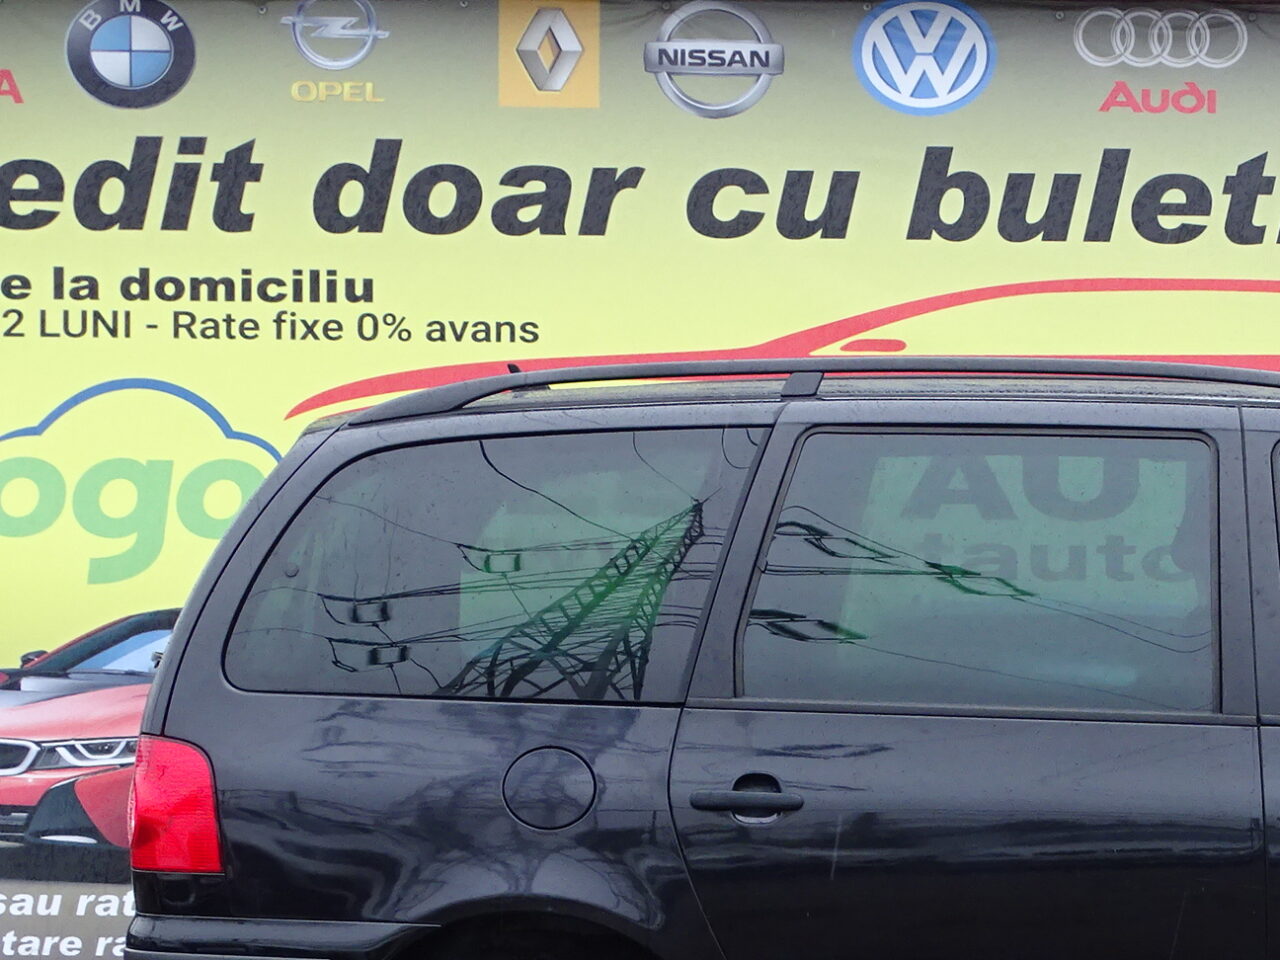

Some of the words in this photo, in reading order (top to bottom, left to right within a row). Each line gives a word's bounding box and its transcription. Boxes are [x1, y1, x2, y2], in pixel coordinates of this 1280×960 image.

[79, 0, 184, 33] BMW
[657, 47, 771, 69] NISSAN
[291, 80, 385, 103] OPEL
[1098, 80, 1218, 115] Audi
[0, 136, 264, 232] edit
[313, 138, 646, 236] doar
[686, 166, 861, 240] cu
[0, 274, 32, 300] e
[53, 266, 100, 300] la
[120, 268, 374, 303] domiciliu
[2, 309, 25, 338] 2
[39, 310, 131, 339] LUNI
[173, 311, 260, 340] Rate
[273, 311, 344, 342] fixe
[357, 313, 413, 342] 0%
[425, 319, 540, 343] avans
[2, 930, 83, 956] tare
